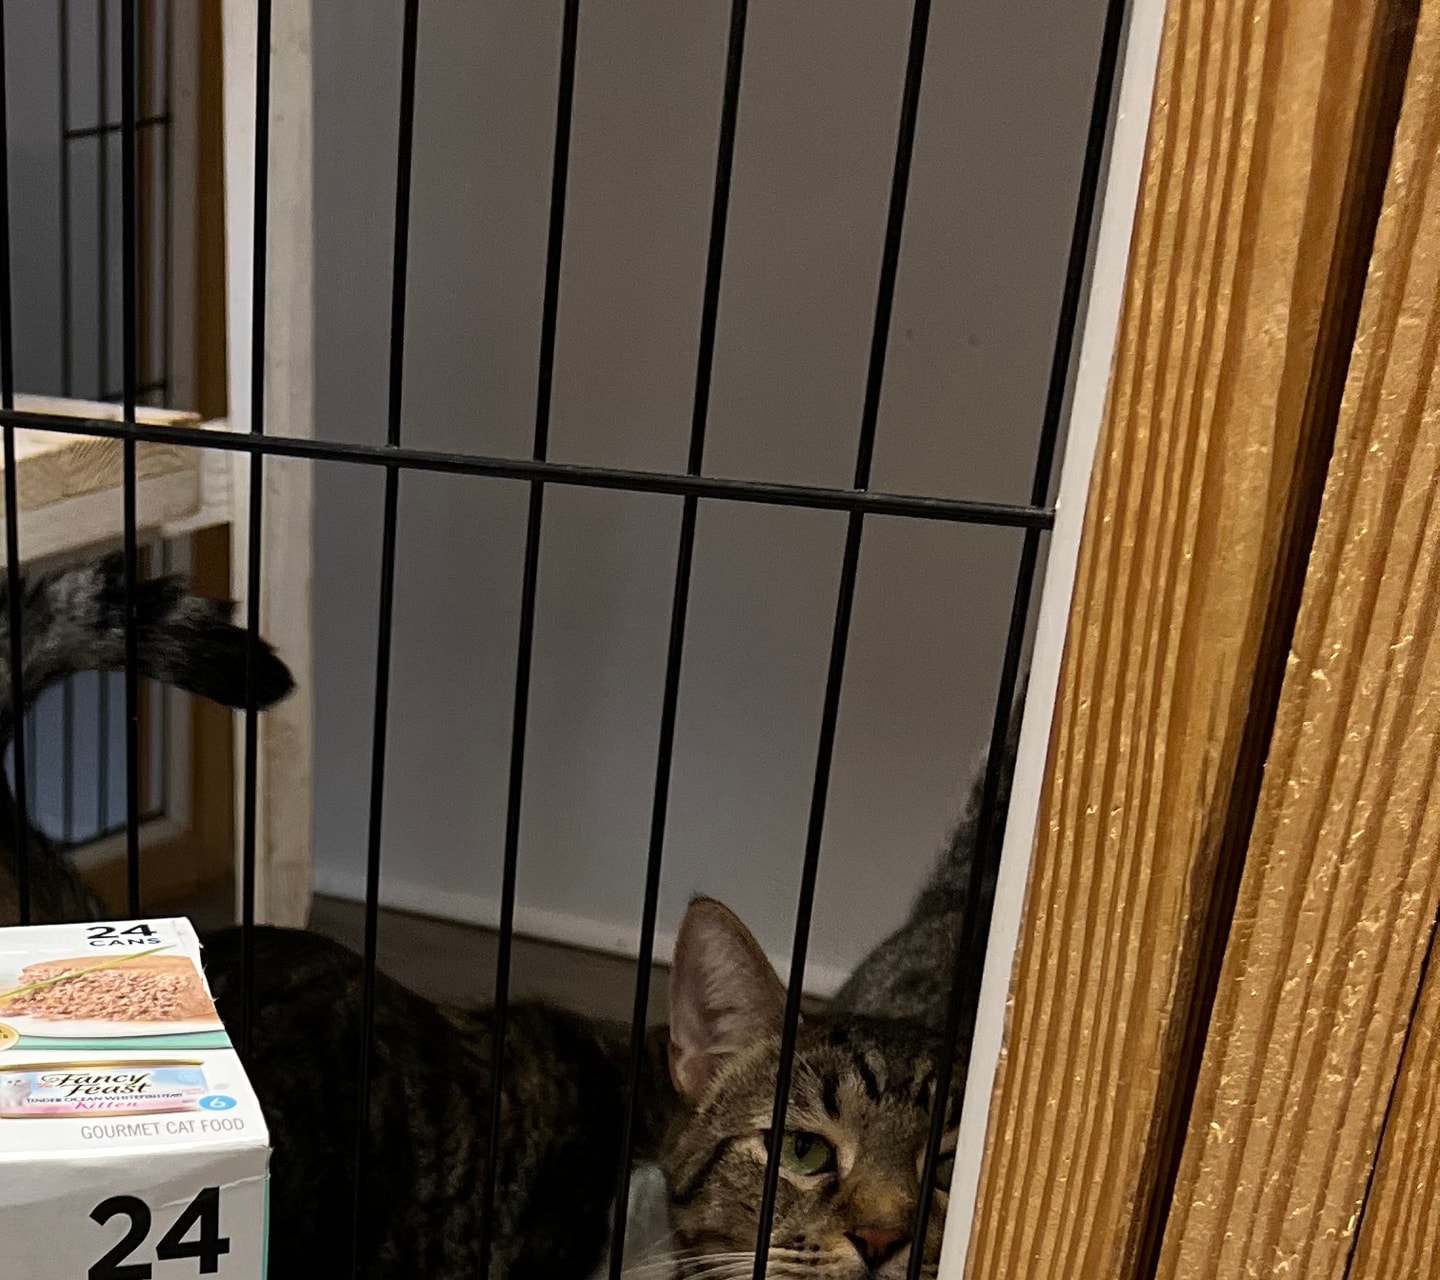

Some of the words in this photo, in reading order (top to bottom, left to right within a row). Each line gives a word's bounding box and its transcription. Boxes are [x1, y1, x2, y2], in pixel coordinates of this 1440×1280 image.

[86, 923, 157, 940] 24
[89, 936, 161, 949] CANS
[80, 1121, 164, 1141] GOURMET
[167, 1119, 198, 1136] CAT
[201, 1118, 245, 1134] FOOD
